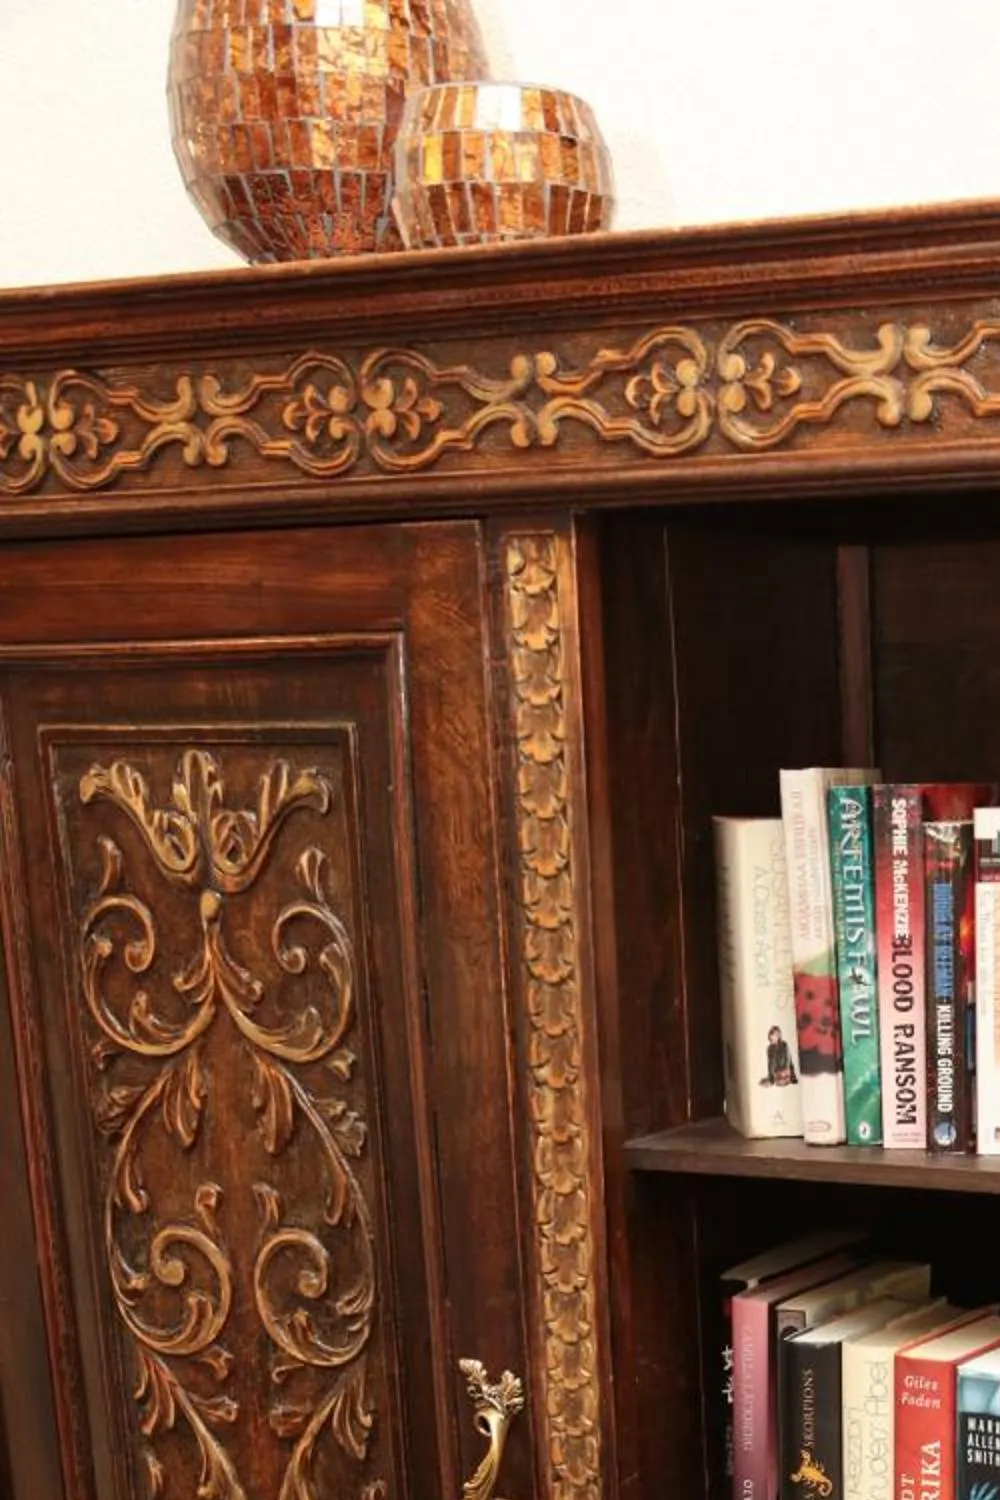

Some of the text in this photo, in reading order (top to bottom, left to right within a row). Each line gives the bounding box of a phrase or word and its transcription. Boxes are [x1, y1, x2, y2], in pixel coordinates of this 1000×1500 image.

[891, 798, 909, 857] SOPHIE
[753, 885, 770, 934] Class
[839, 798, 865, 952] ARTEMIS
[774, 932, 793, 1011] LEWIS
[892, 934, 917, 1125] BLOOD RANSOM
[940, 1003, 957, 1113] KILLING GROUND
[801, 1368, 815, 1450] SKORPIONS
[864, 1359, 889, 1418] Abel
[904, 1375, 939, 1392] Giles
